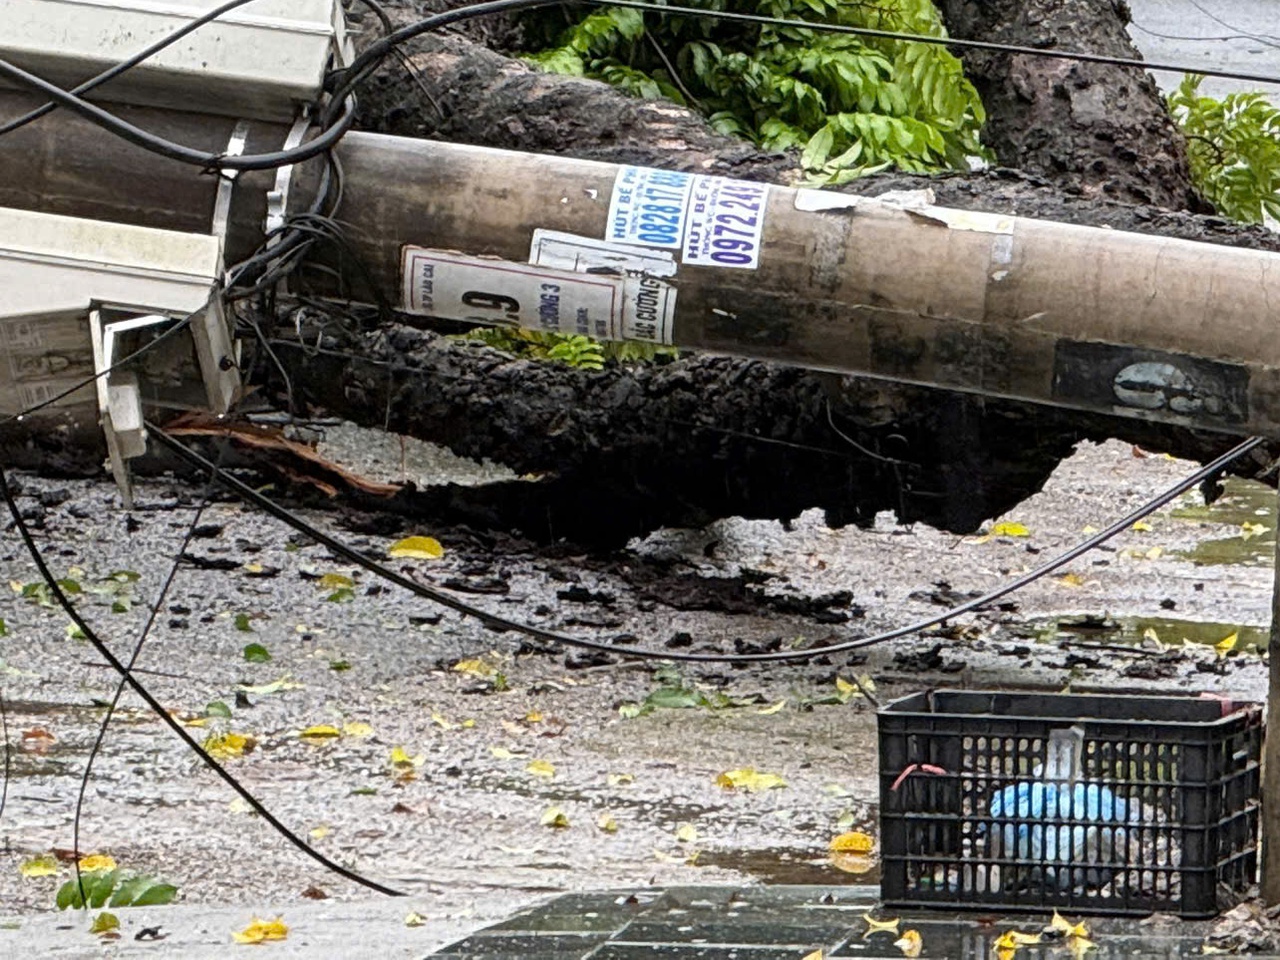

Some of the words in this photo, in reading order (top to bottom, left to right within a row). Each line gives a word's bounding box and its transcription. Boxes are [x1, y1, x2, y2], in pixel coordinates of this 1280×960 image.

[617, 185, 633, 204] BẾ
[694, 190, 708, 213] BẾ
[612, 207, 630, 239] HÚT
[687, 219, 703, 259] HÚT
[541, 283, 560, 294] 3
